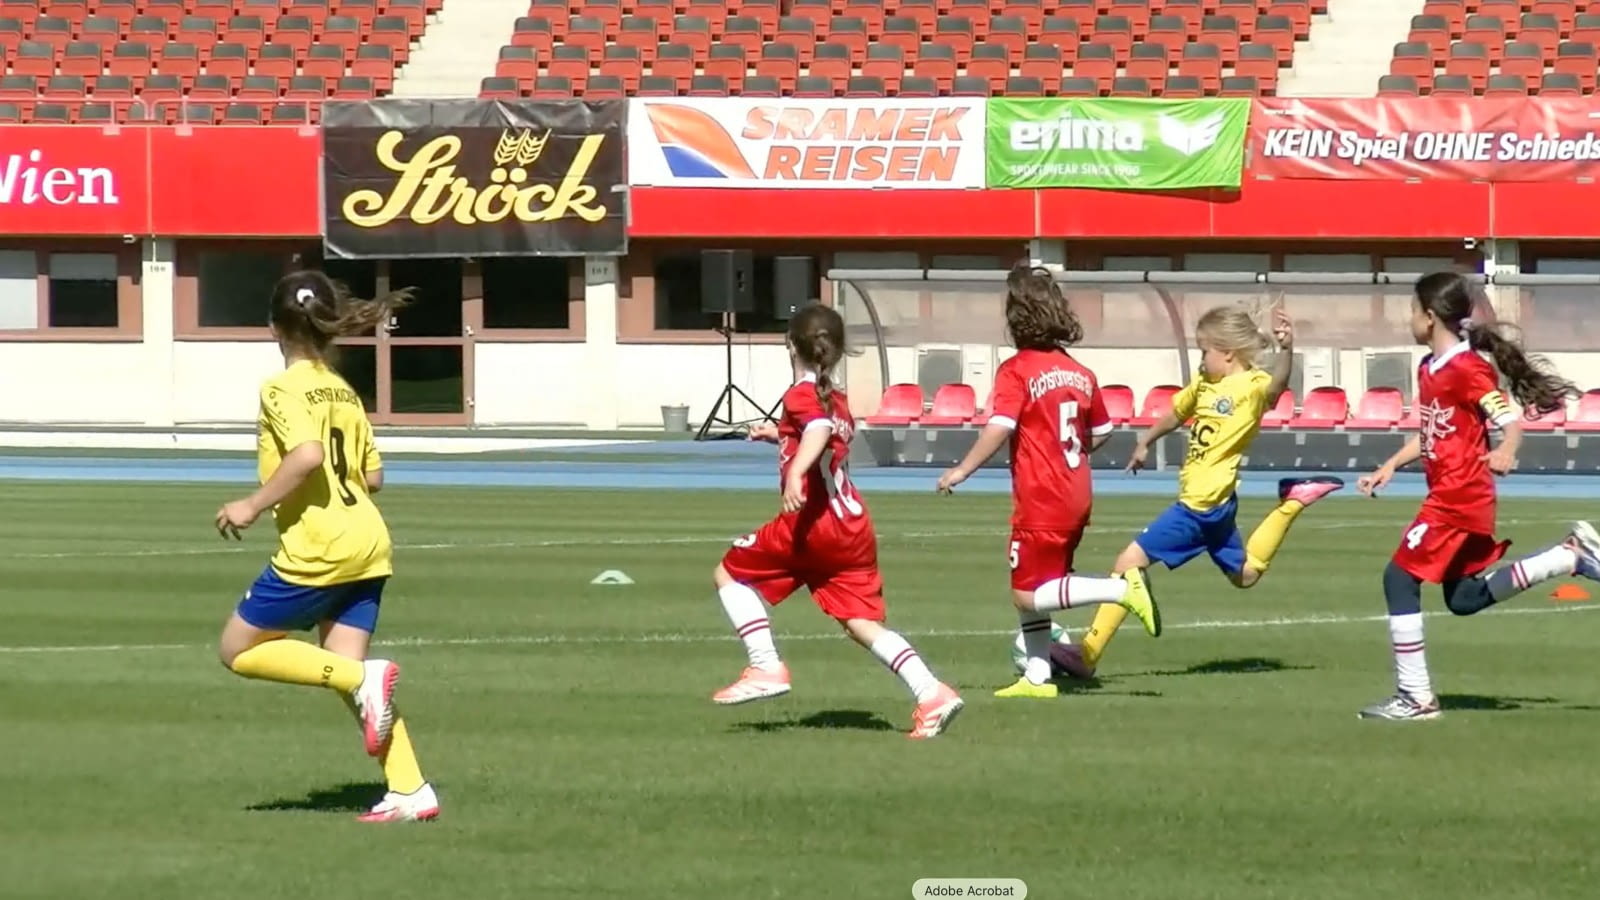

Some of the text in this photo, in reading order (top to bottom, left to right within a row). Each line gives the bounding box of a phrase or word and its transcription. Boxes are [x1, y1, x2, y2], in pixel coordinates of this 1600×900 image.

[741, 106, 971, 141] SRAMEK
[1010, 111, 1145, 151] erima
[762, 145, 960, 181] REISEN
[1263, 128, 1333, 158] KEIN
[1337, 130, 1406, 166] Spiel
[1413, 131, 1493, 162] OHNE
[342, 130, 607, 228] Ströck
[1059, 400, 1081, 469] 5
[1009, 540, 1021, 569] 5
[1406, 522, 1429, 550] 4
